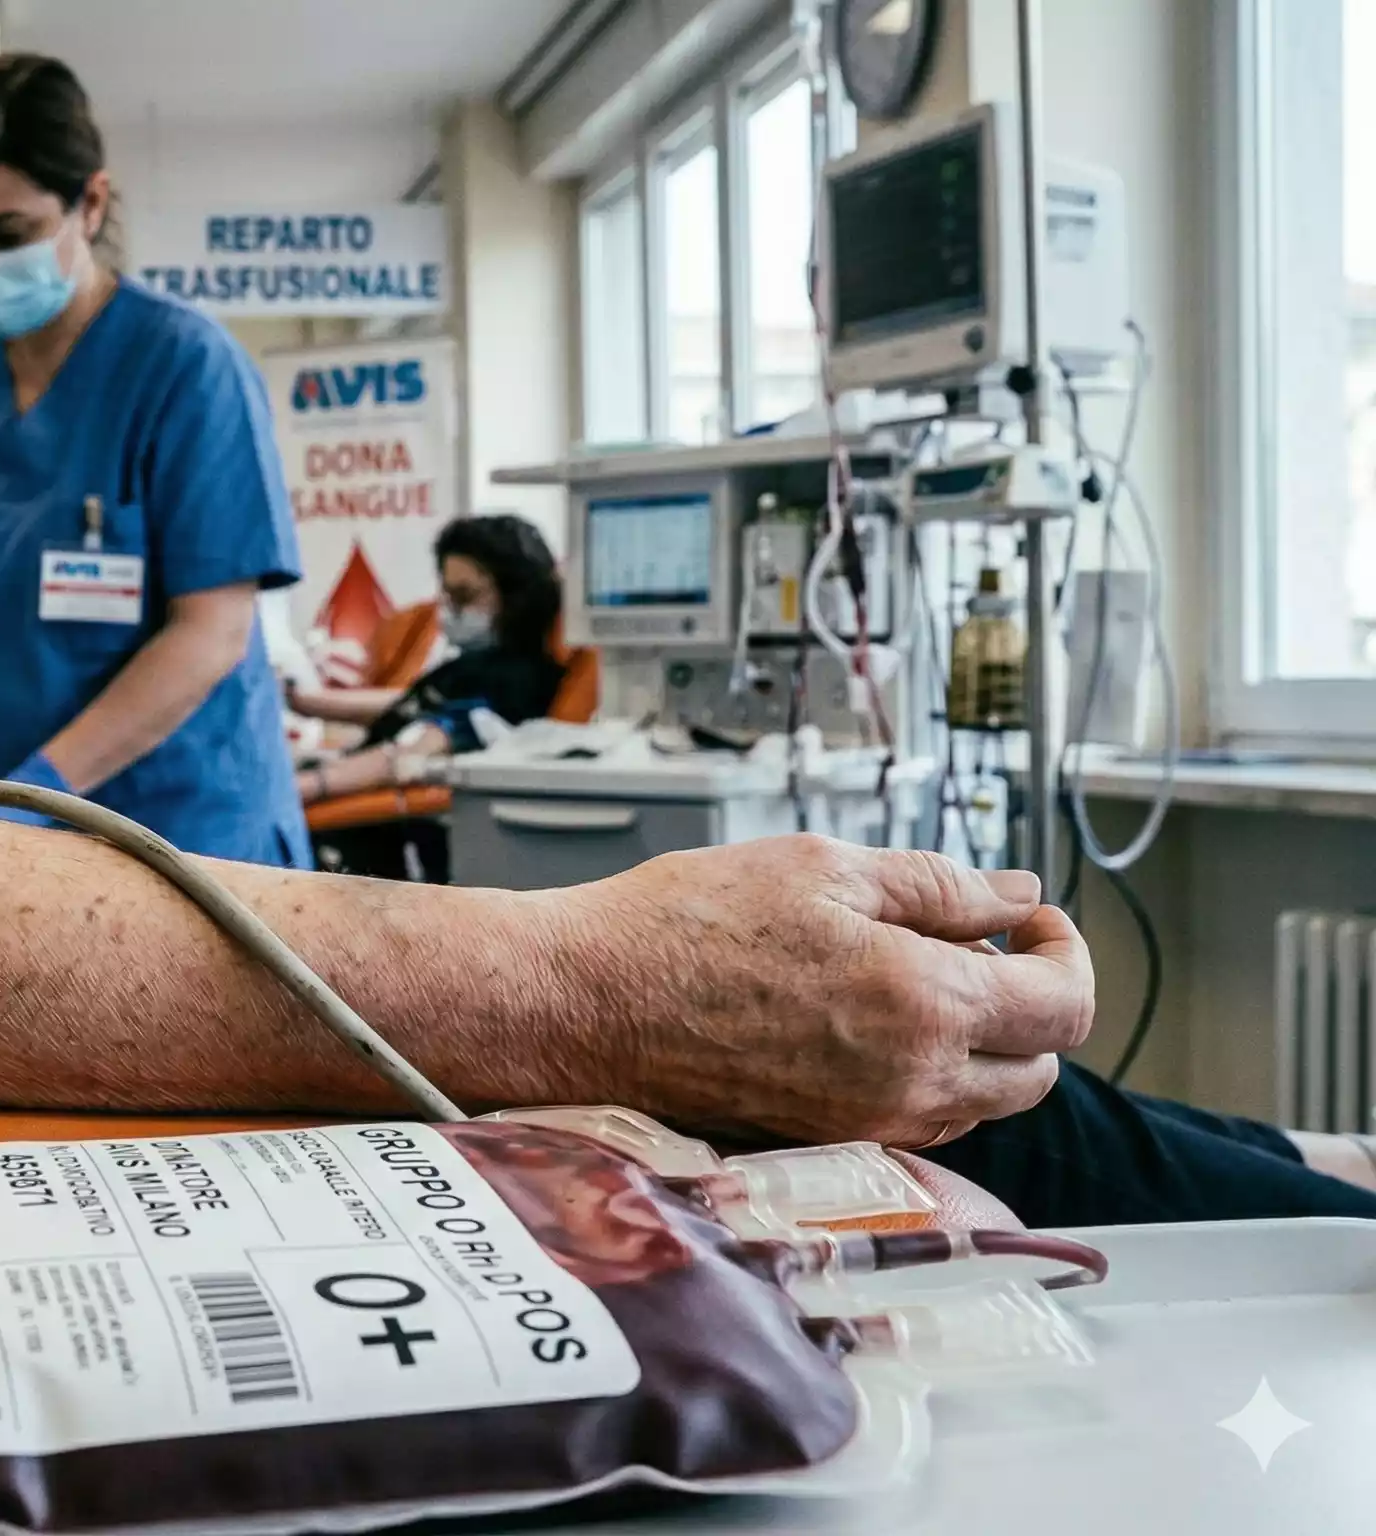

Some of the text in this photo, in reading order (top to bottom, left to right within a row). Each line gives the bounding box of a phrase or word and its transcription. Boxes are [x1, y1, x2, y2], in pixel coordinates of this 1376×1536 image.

[205, 215, 374, 252] REPARTO
[291, 359, 427, 411] AVIS
[305, 439, 413, 479] DONA
[102, 1142, 192, 1238] AVIS MILANO
[357, 1128, 466, 1210] GRUPPO
[498, 1289, 589, 1364] POS
